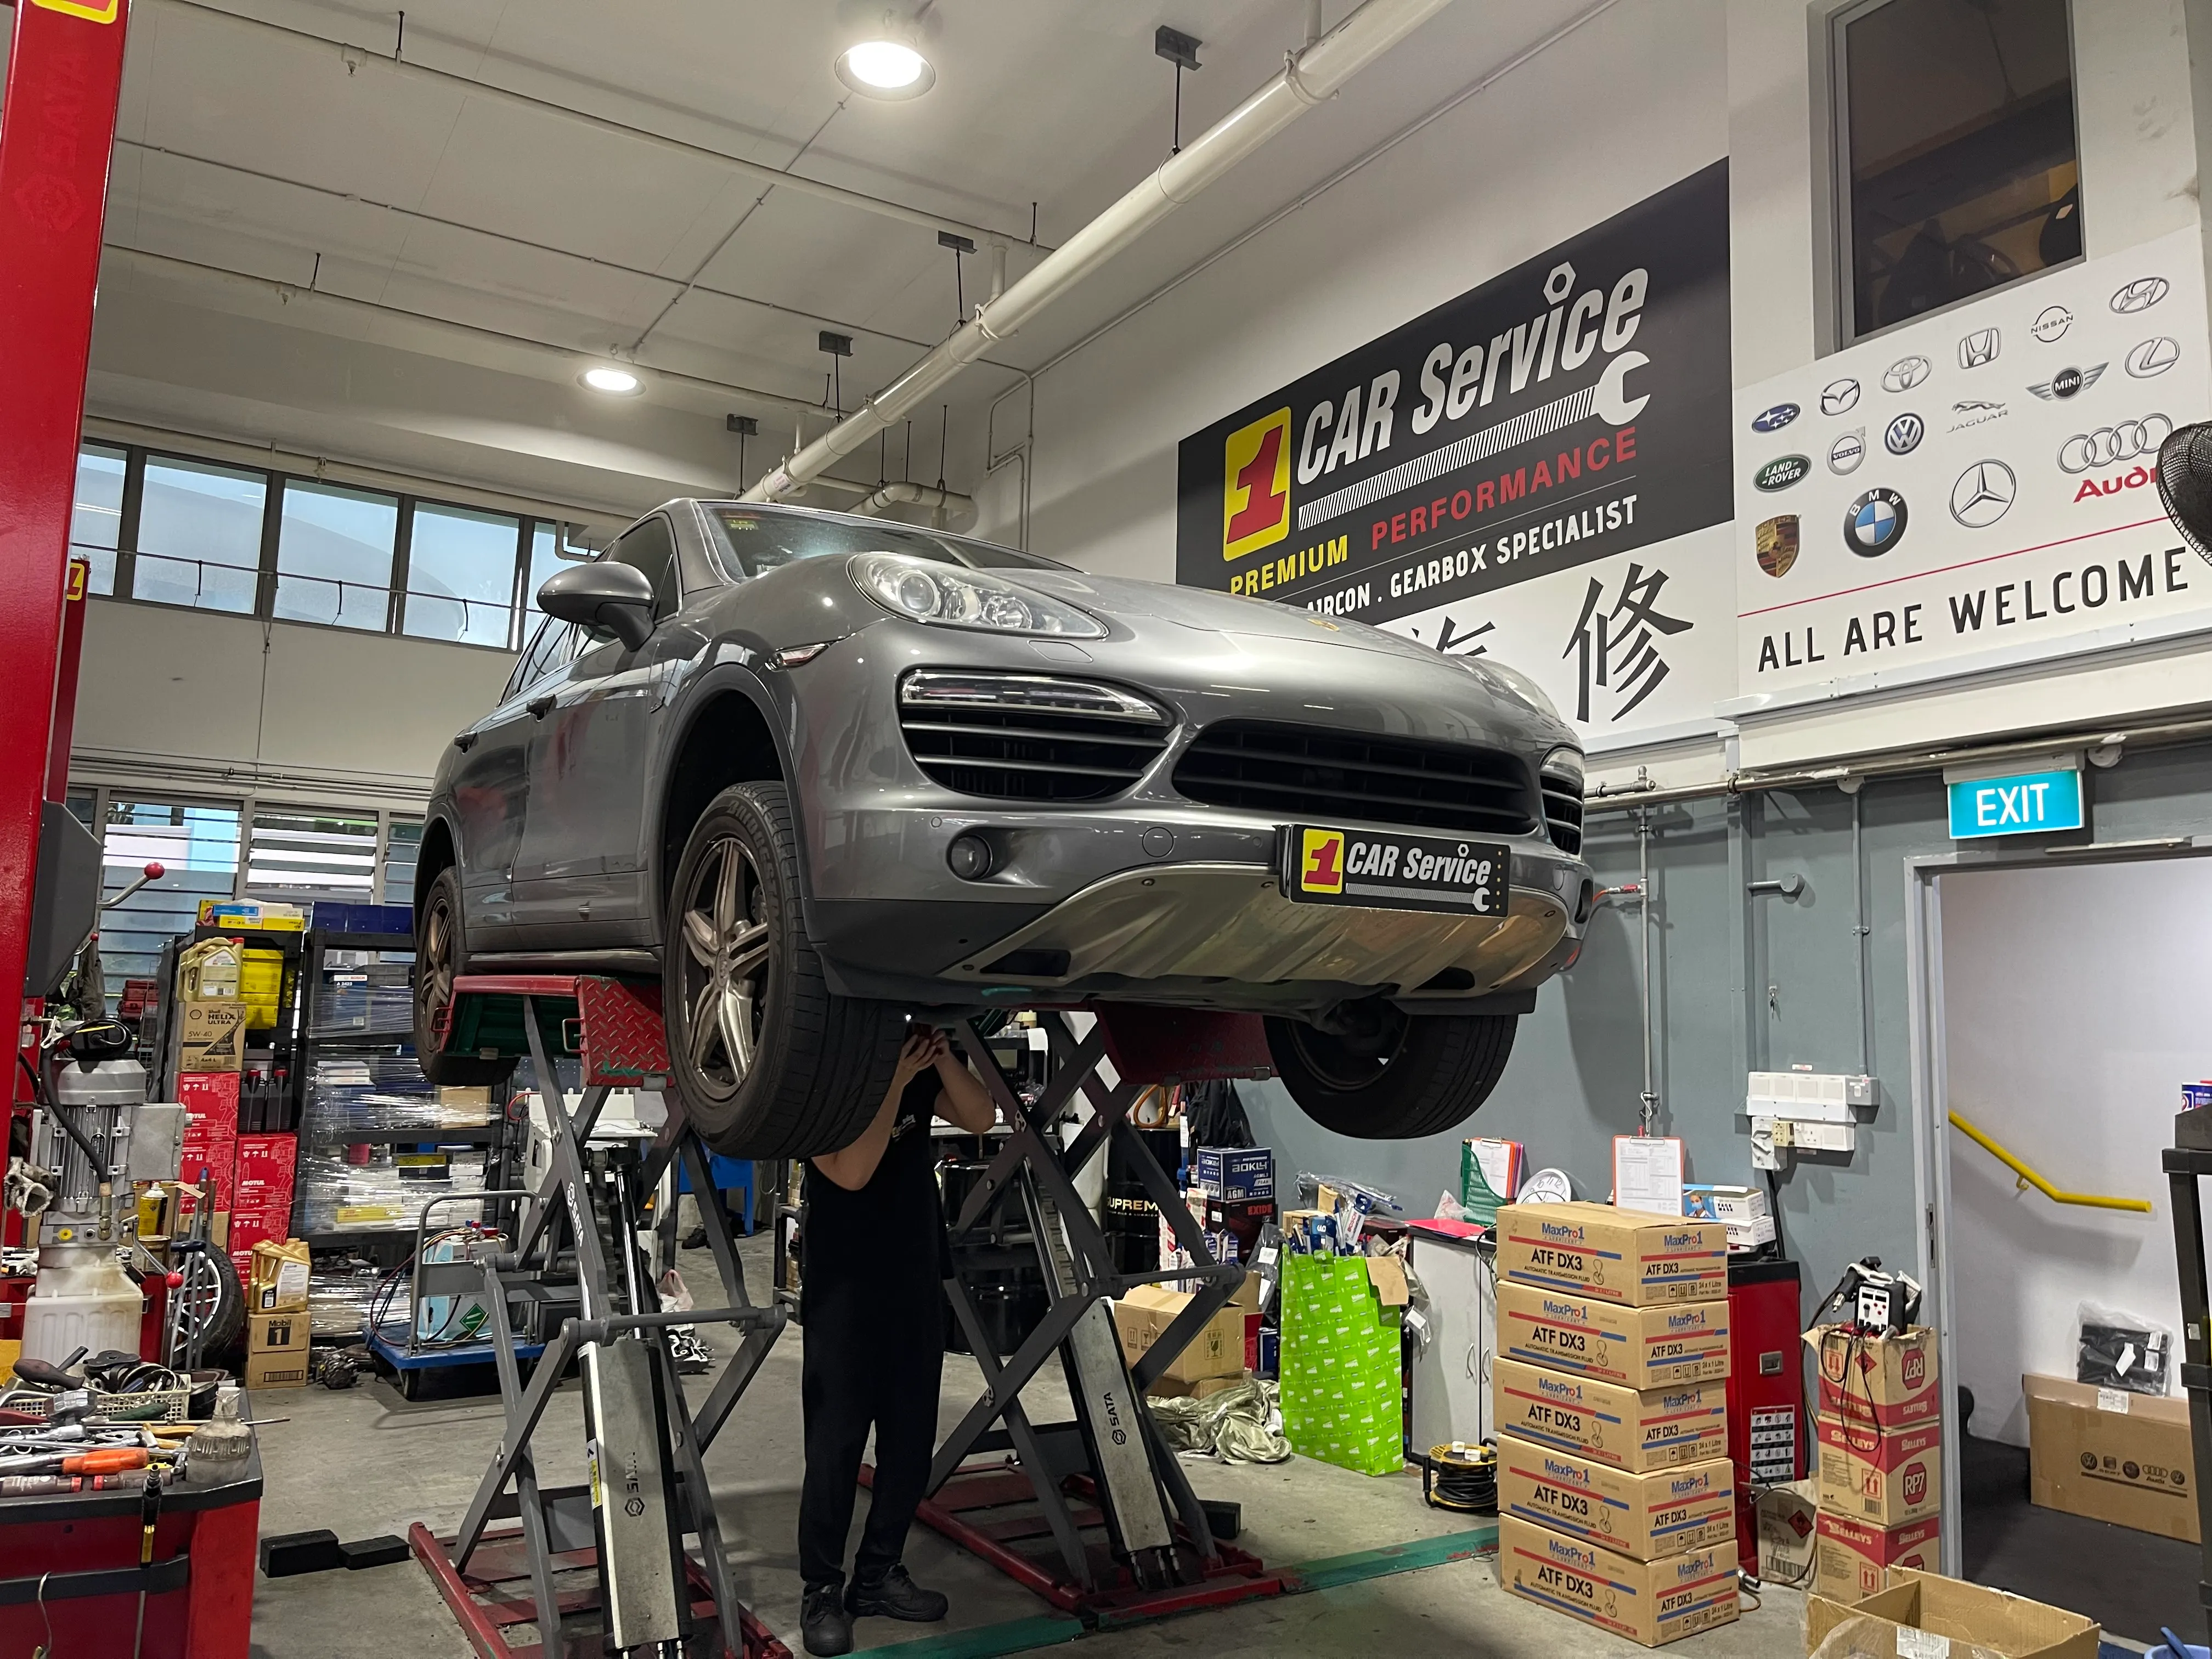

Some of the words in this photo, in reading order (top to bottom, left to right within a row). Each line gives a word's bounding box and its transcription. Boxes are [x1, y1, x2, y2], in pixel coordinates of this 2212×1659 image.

[2031, 314, 2073, 334] NISSAN
[2055, 375, 2080, 391] MINI
[1226, 425, 1287, 544] 1
[1297, 369, 1400, 484] CAR
[1413, 261, 1648, 434] Service
[1946, 409, 2008, 433] JAGUAR
[1833, 447, 1860, 460] VOLVO
[1231, 535, 1347, 596] PREMIUM
[1372, 426, 1637, 550] PERFORMANCE
[1391, 545, 1486, 598] GEARBOX
[1497, 494, 1638, 563] SPECIALIST
[1758, 627, 1825, 673] ALL
[1844, 603, 1923, 656] ARE
[1949, 546, 2188, 634] WELCOME
[1976, 783, 2049, 826] EXIT
[1304, 839, 1340, 885] 1
[1346, 842, 1400, 877] CAR
[1403, 843, 1492, 885] Service
[1108, 1197, 1159, 1212] UPREM
[1227, 1188, 1244, 1200] AGM
[1247, 1204, 1273, 1216] EXIDE
[572, 1201, 584, 1247] SATA
[1347, 1211, 1357, 1232] BOSCH
[1542, 1222, 1585, 1240] MaxPro1
[1664, 1231, 1702, 1246] MaxPro1
[1531, 1248, 1554, 1265] ATF
[1558, 1252, 1582, 1271] DX3
[1646, 1263, 1661, 1276] ATF
[1663, 1262, 1679, 1274] DX3
[1524, 1265, 1547, 1274] AUTOMATIC
[1548, 1269, 1578, 1280] TRANSMISSION
[1578, 1274, 1590, 1283] FLUID
[1544, 1300, 1587, 1319] MaxPro1
[1668, 1310, 1706, 1327] MaxPro1
[274, 1328, 283, 1344] 1
[1532, 1325, 1556, 1344] ATF
[1560, 1332, 1585, 1351] DX3
[1525, 1343, 1549, 1353] AUTOMATIC
[1550, 1348, 1581, 1360] TRANSMISSION
[1581, 1355, 1594, 1363] FLUID
[1651, 1346, 1666, 1358] ATF
[1667, 1344, 1683, 1356] DX3
[1904, 1357, 1923, 1381] RP7
[1539, 1378, 1583, 1400] MaxPro1
[1663, 1389, 1702, 1408] MaxPro1
[1103, 1392, 1120, 1426] SATA
[1528, 1403, 1551, 1423] ATF
[1555, 1410, 1580, 1431] DX3
[1521, 1420, 1544, 1431] AUTOMATIC
[1545, 1427, 1576, 1441] TRANSMISSION
[1576, 1436, 1589, 1444] FLUID
[1646, 1427, 1661, 1441] ATF
[1663, 1425, 1679, 1437] DX3
[1830, 1430, 1875, 1450] SELLEYS
[1901, 1437, 1926, 1451] SELLEYS
[1545, 1459, 1590, 1483] MaxPro1
[1672, 1472, 1709, 1493] MaxPro1
[1904, 1471, 1925, 1496] RP7
[1534, 1484, 1558, 1504] ATF
[1561, 1492, 1588, 1515] DX3
[1527, 1501, 1551, 1514] AUTOMATIC
[1551, 1508, 1583, 1524] TRANSMISSION
[1584, 1520, 1596, 1528] FLUID
[1654, 1513, 1669, 1527] ATF
[1671, 1509, 1686, 1523] DX3
[1829, 1523, 1872, 1545] SELLEYS
[1898, 1530, 1925, 1545] SELLEYS
[1549, 1539, 1595, 1567] MaxPro1
[1678, 1552, 1714, 1577] MaxPro1
[1538, 1564, 1563, 1586] ATF
[1566, 1574, 1593, 1599] DX3
[1530, 1582, 1555, 1595] AUTOMATIC
[1556, 1590, 1589, 1608] TRANSMISSION
[1589, 1604, 1602, 1612] FLUID
[1661, 1597, 1675, 1613] ATF
[1677, 1592, 1692, 1607] DX3
